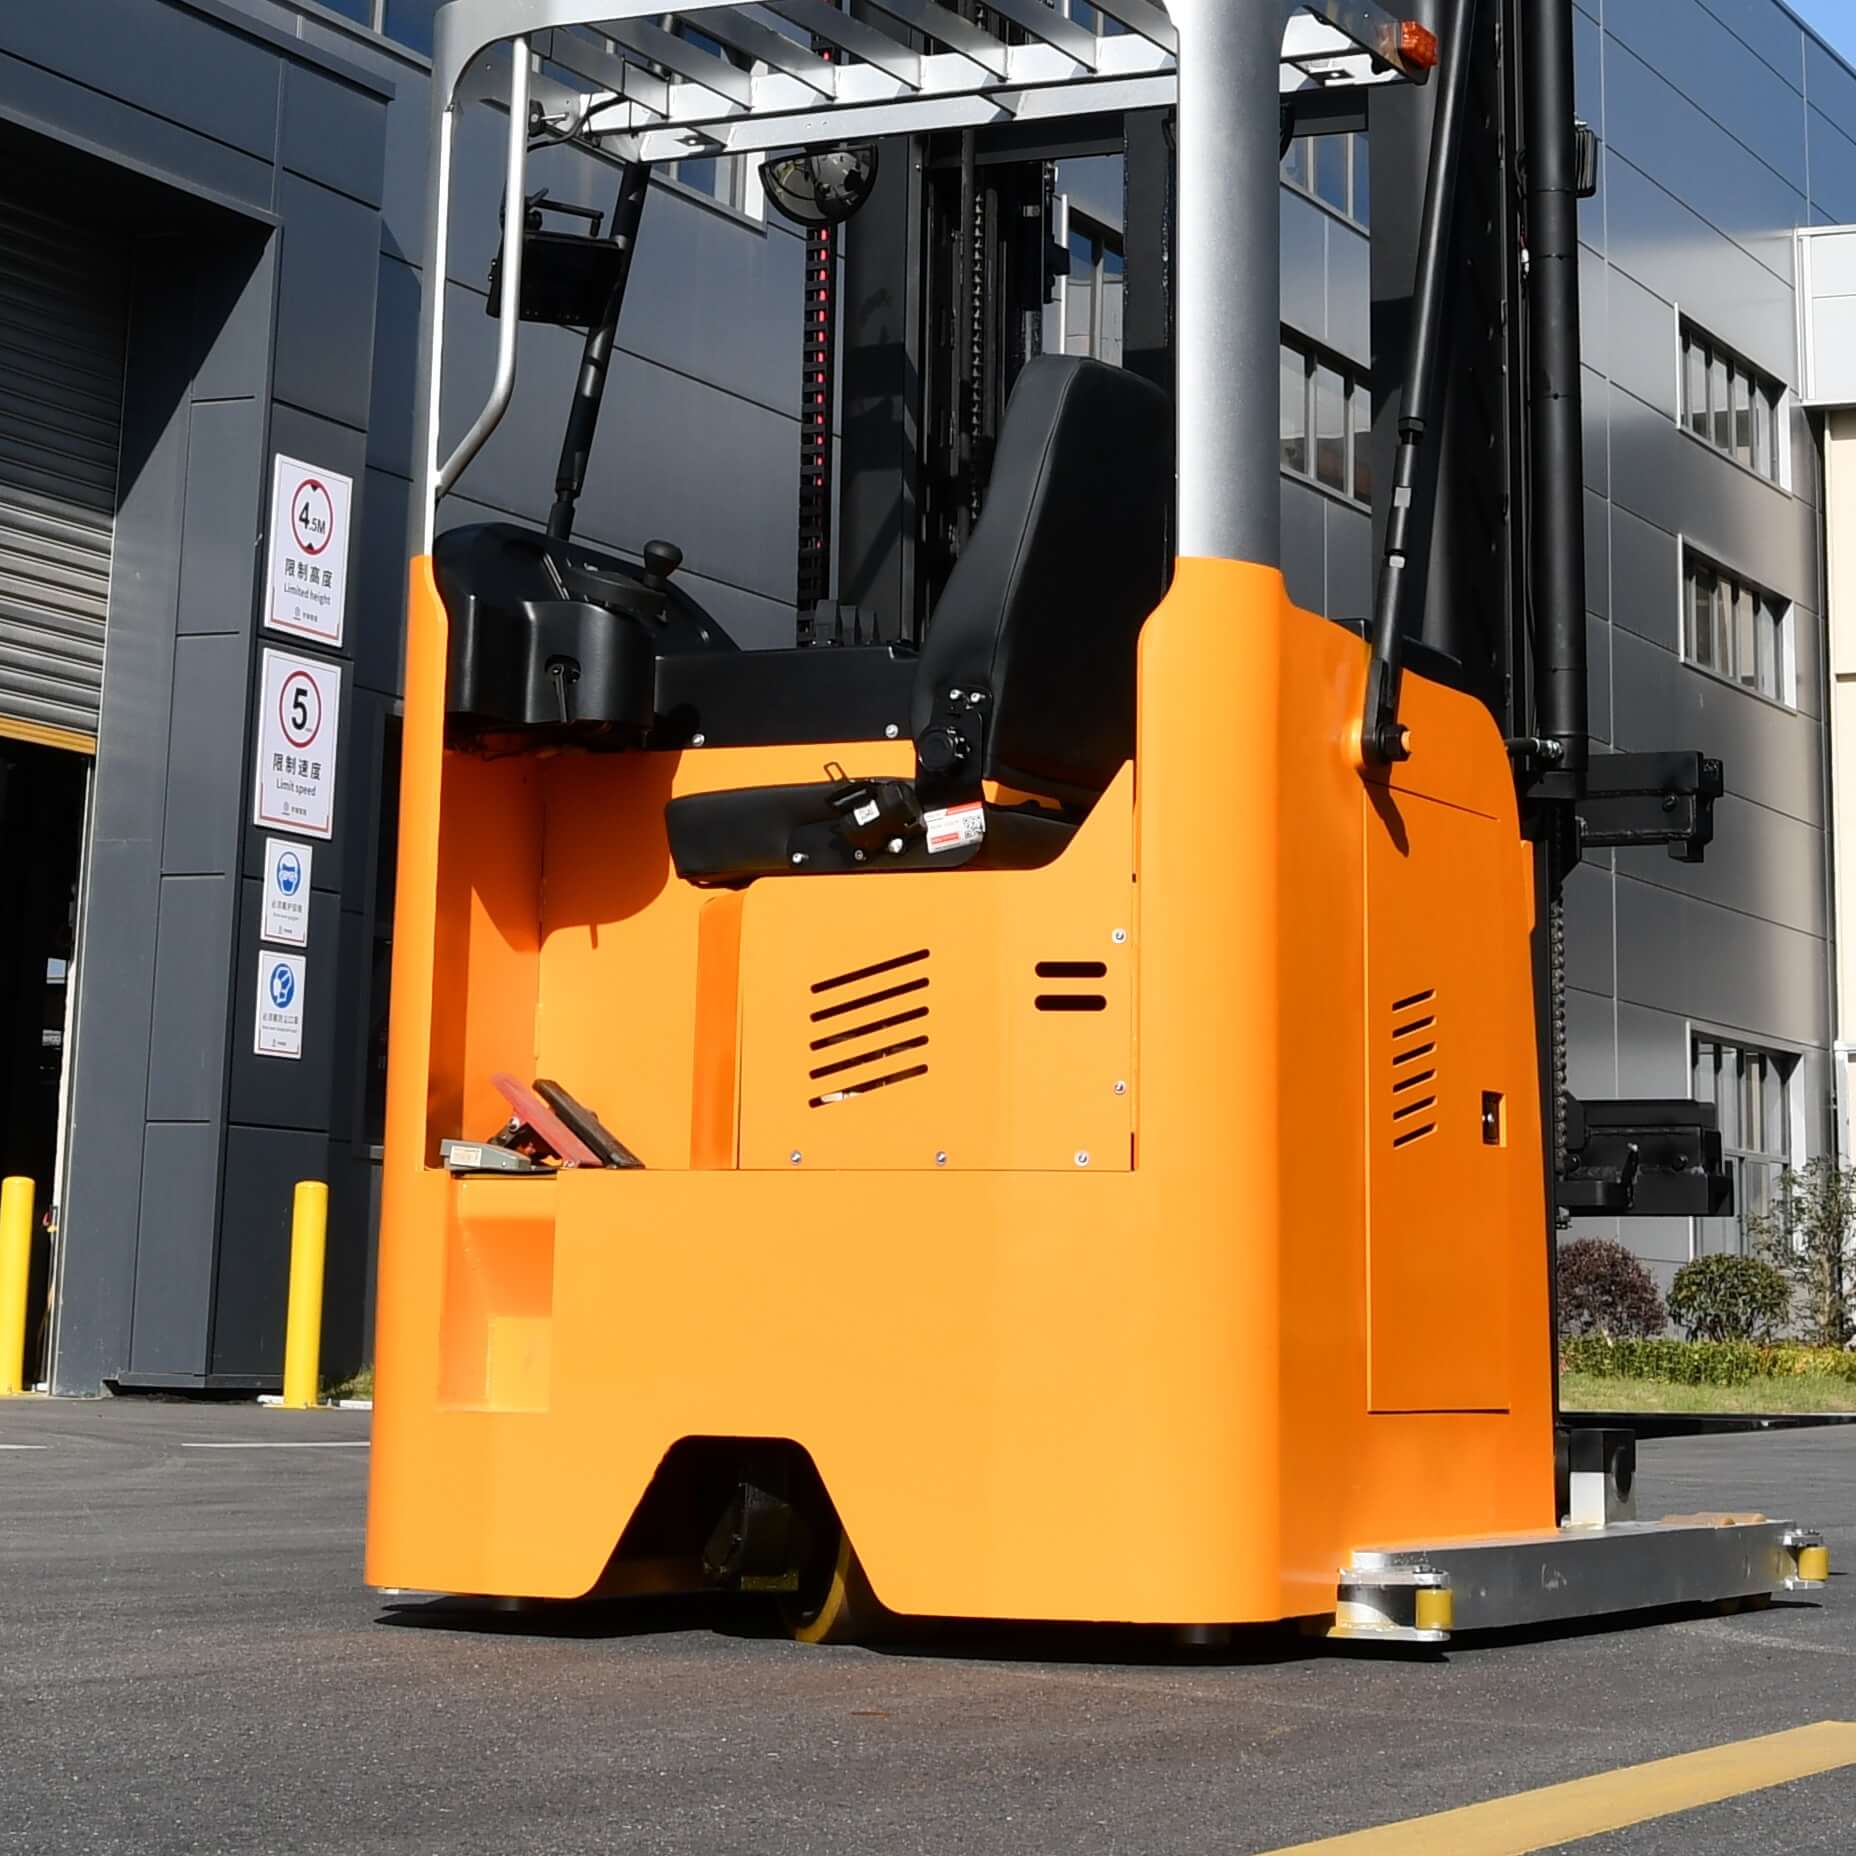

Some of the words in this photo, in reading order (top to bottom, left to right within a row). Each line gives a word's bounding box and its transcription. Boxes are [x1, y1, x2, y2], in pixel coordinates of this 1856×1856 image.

[284, 557, 333, 589] 限制高度
[284, 583, 309, 599] Limited
[310, 590, 331, 606] height
[291, 687, 308, 731] 5
[272, 752, 321, 781] 限制速度
[276, 777, 294, 792] Limit
[295, 784, 316, 797] speed
